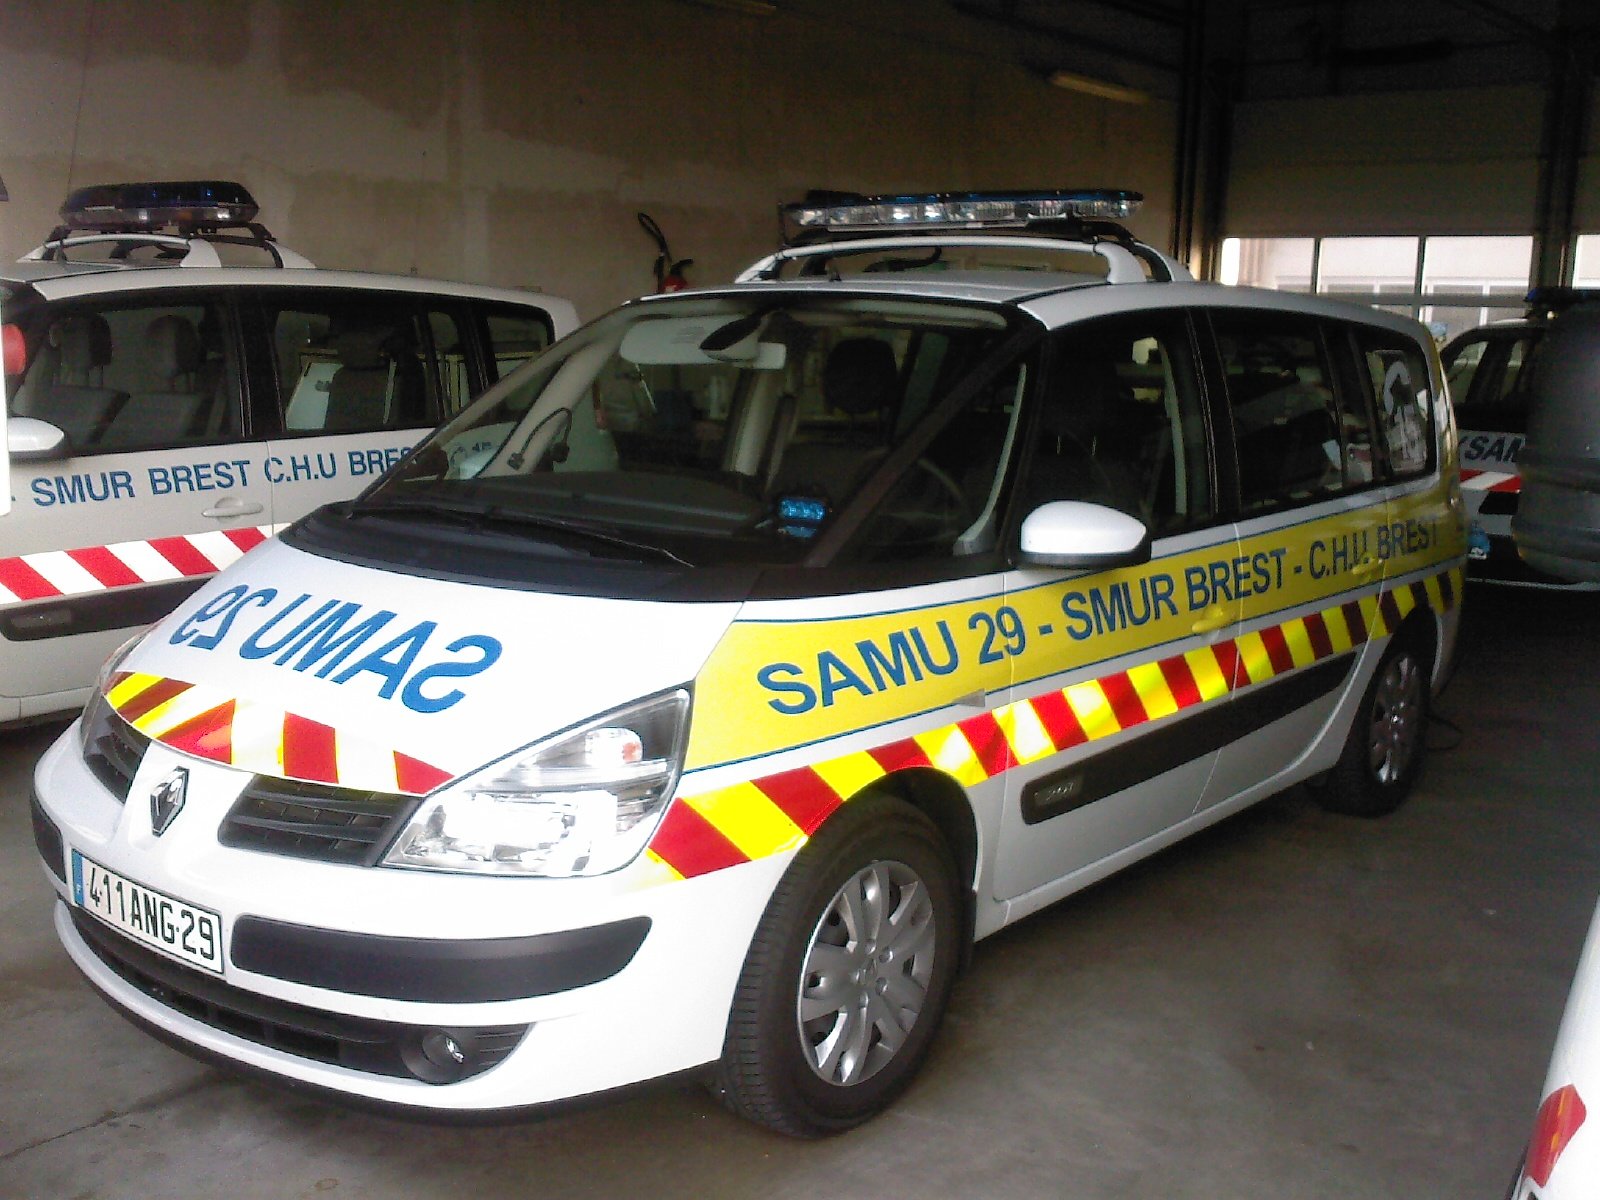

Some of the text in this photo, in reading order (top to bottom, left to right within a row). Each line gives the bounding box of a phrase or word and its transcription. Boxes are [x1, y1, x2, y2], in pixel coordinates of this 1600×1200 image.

[31, 471, 135, 506] SMUR
[148, 460, 249, 495] BREST
[757, 620, 959, 715] SAMU
[968, 605, 1026, 664] 29
[1061, 573, 1178, 641] SMUR
[1184, 548, 1287, 611] BREST
[1377, 519, 1437, 560] BREST
